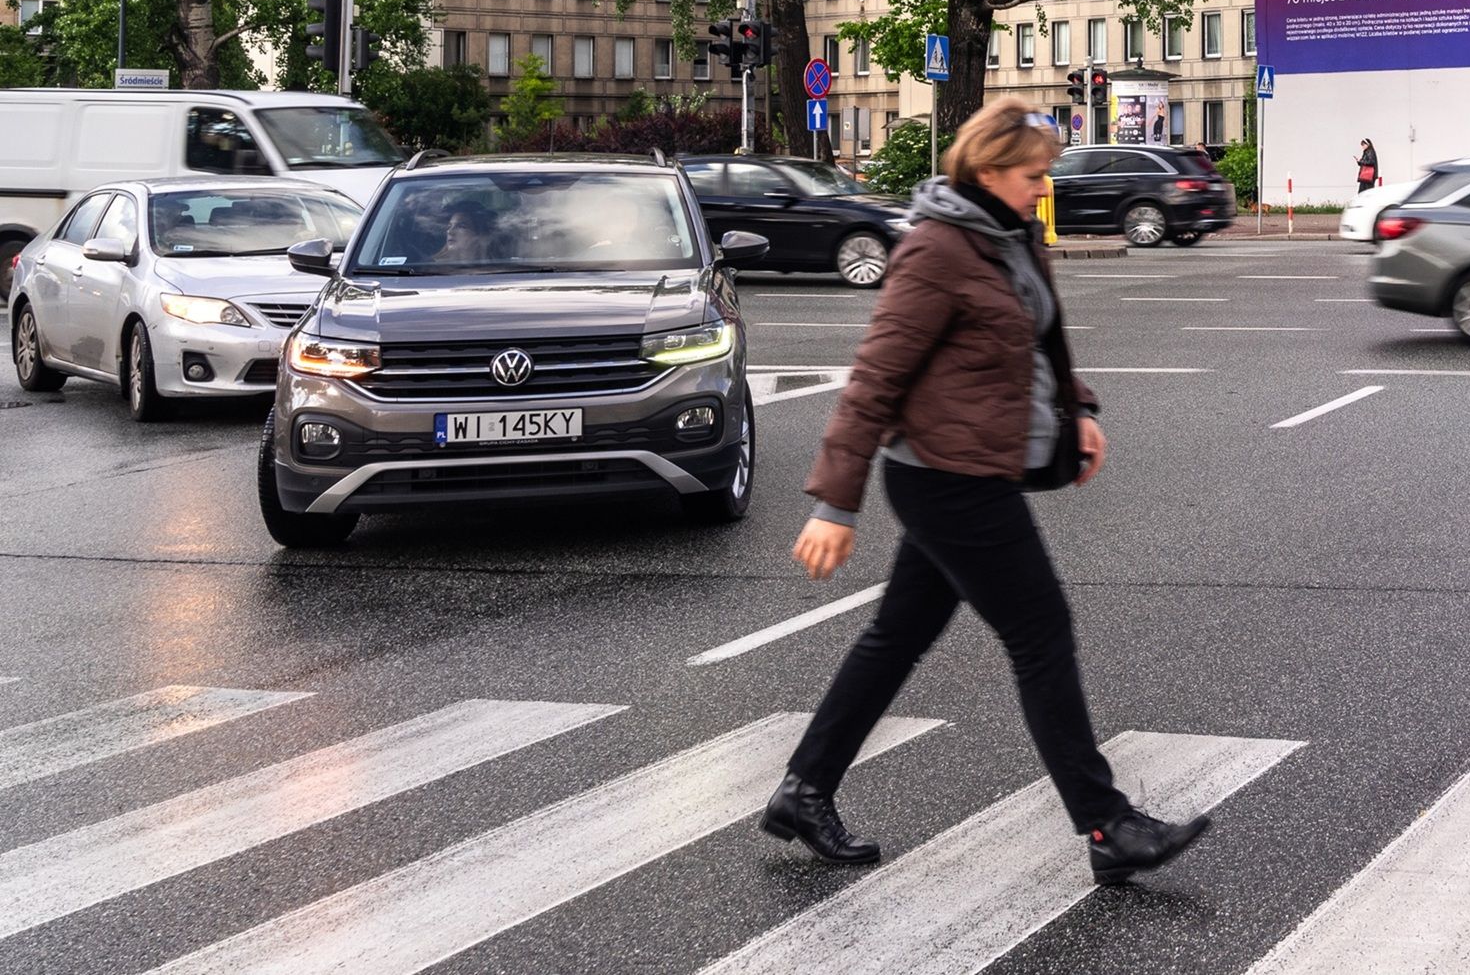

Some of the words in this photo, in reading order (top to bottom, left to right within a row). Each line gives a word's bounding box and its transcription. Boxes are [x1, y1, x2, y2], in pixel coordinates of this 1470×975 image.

[120, 75, 163, 85] Śródmieście
[454, 415, 481, 440] WI
[498, 411, 575, 438] 145KY
[436, 431, 446, 439] PL
